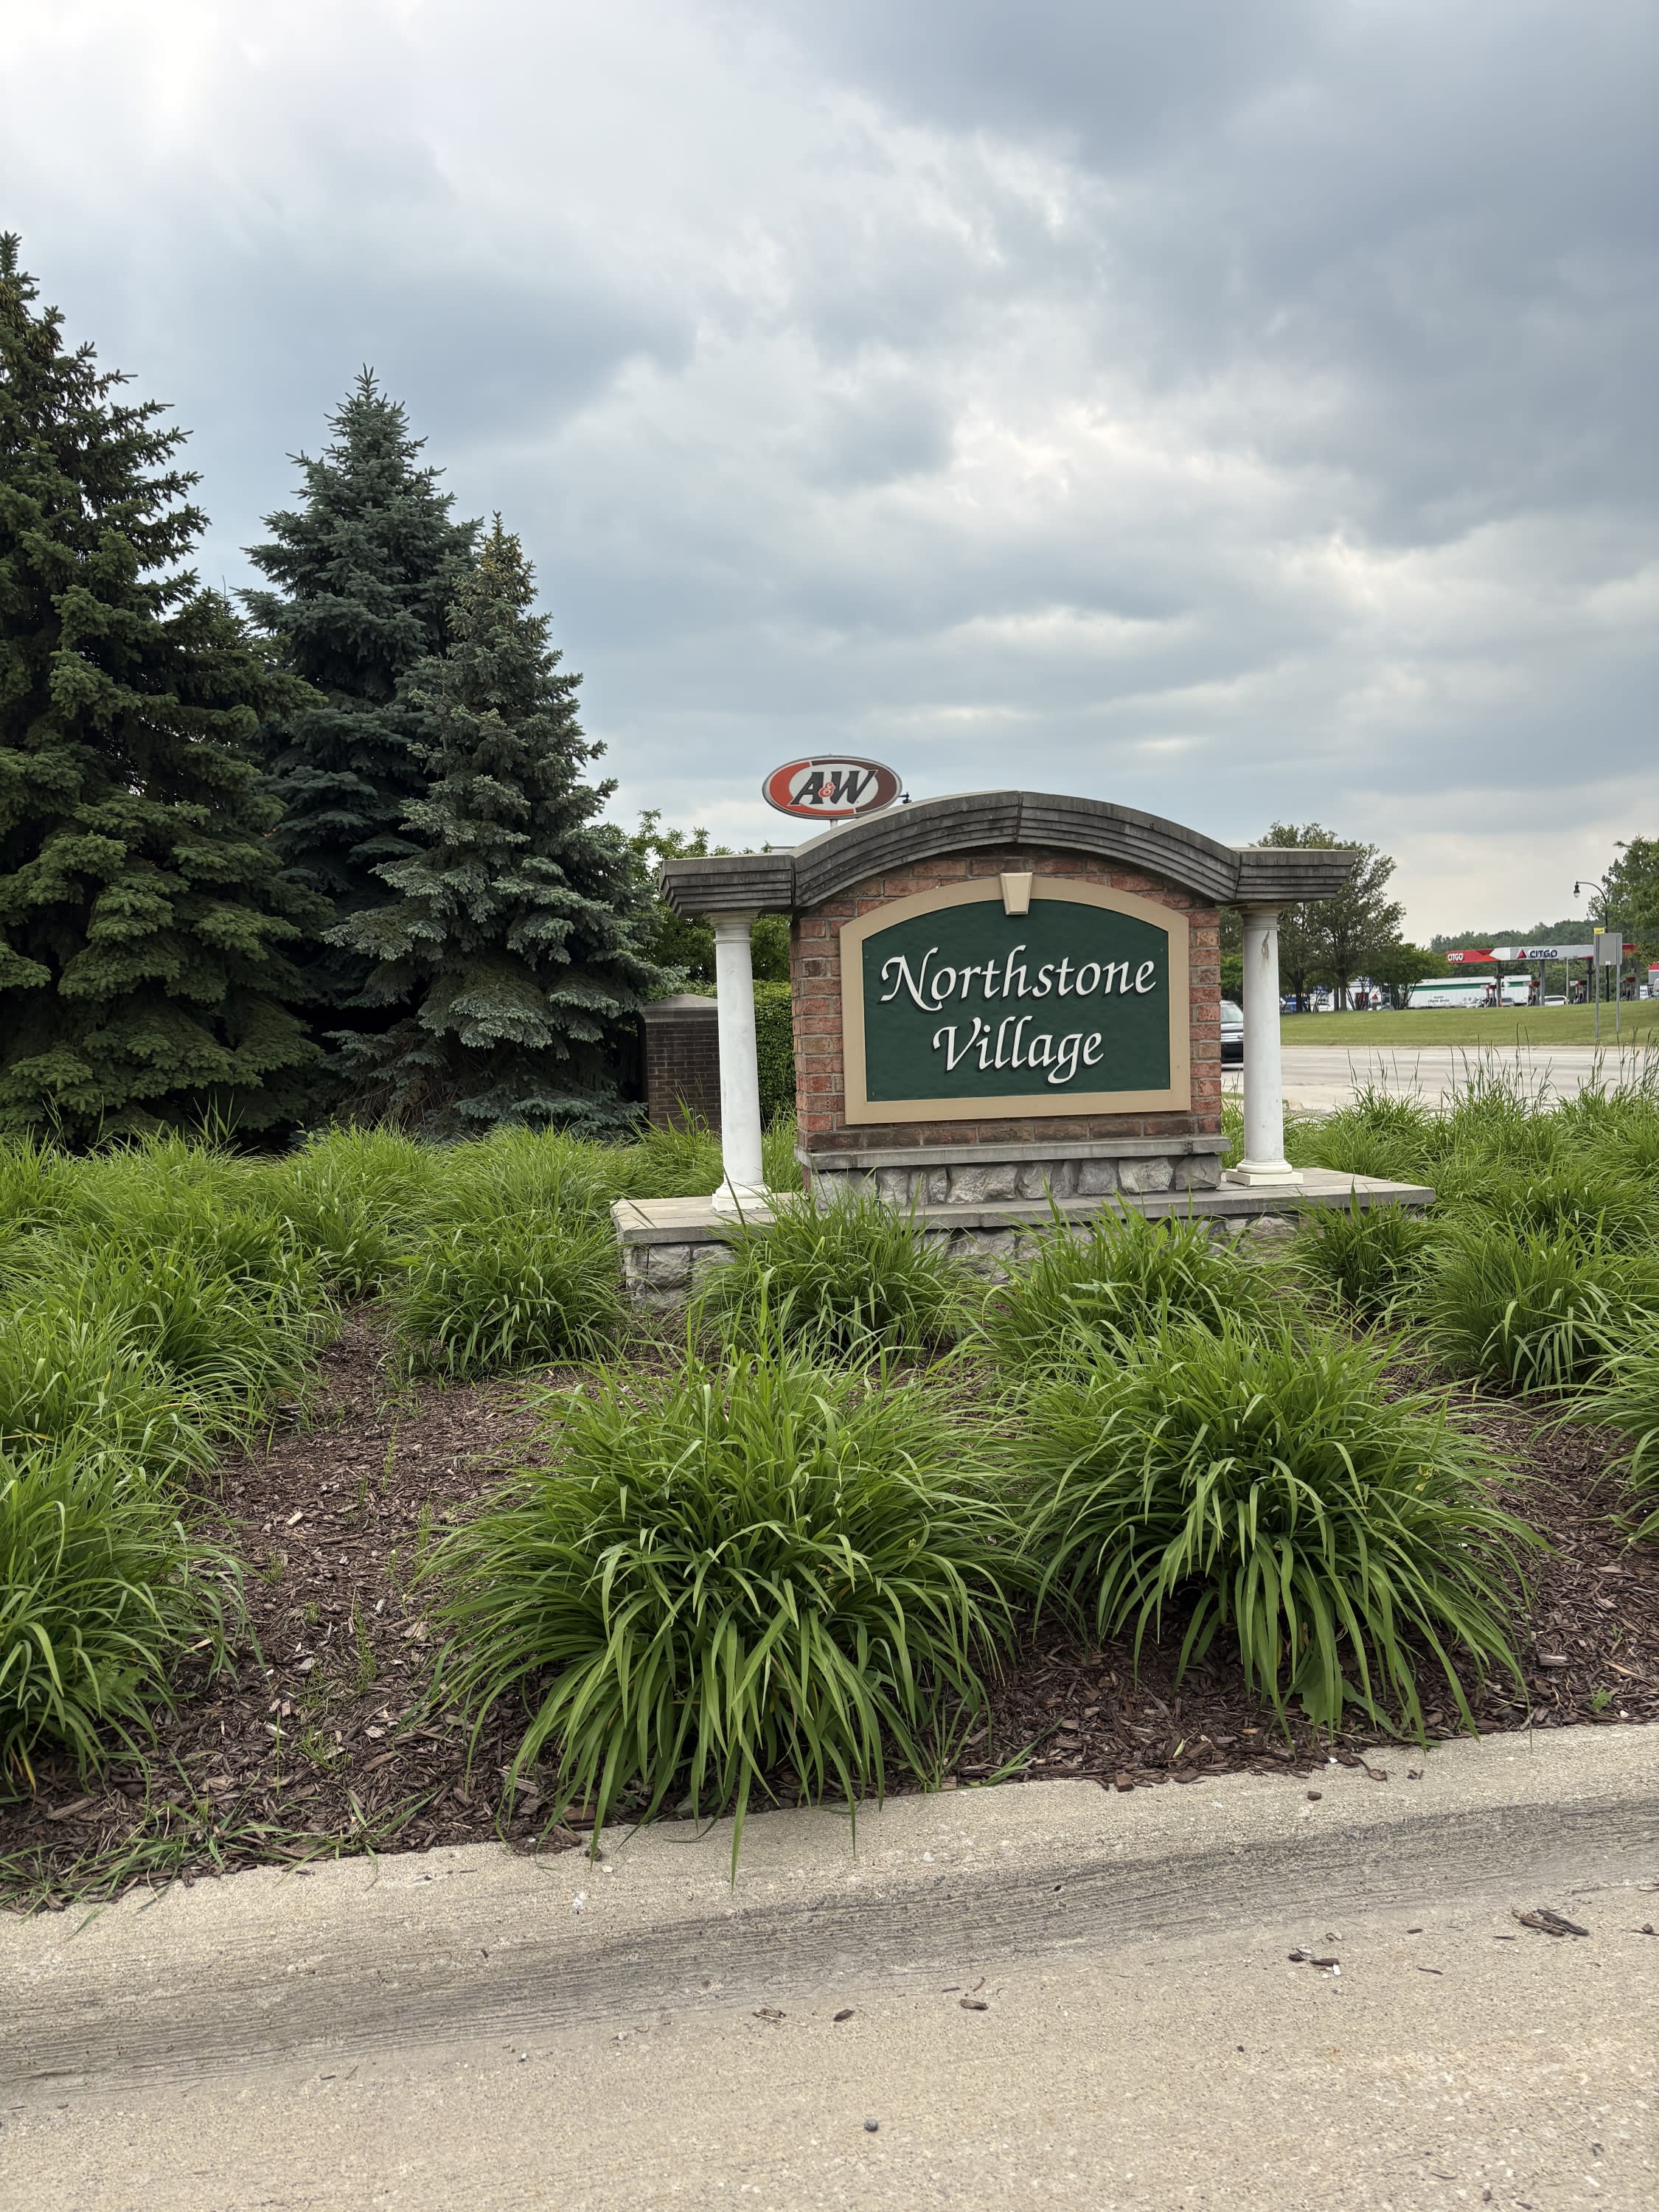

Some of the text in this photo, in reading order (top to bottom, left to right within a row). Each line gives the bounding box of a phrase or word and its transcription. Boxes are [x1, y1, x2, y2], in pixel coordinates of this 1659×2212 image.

[788, 770, 878, 805] A&W
[1447, 952, 1464, 961] CITGO
[1528, 949, 1558, 959] CITGO
[880, 945, 1157, 1011] Northstone
[932, 1015, 1105, 1085] Village
